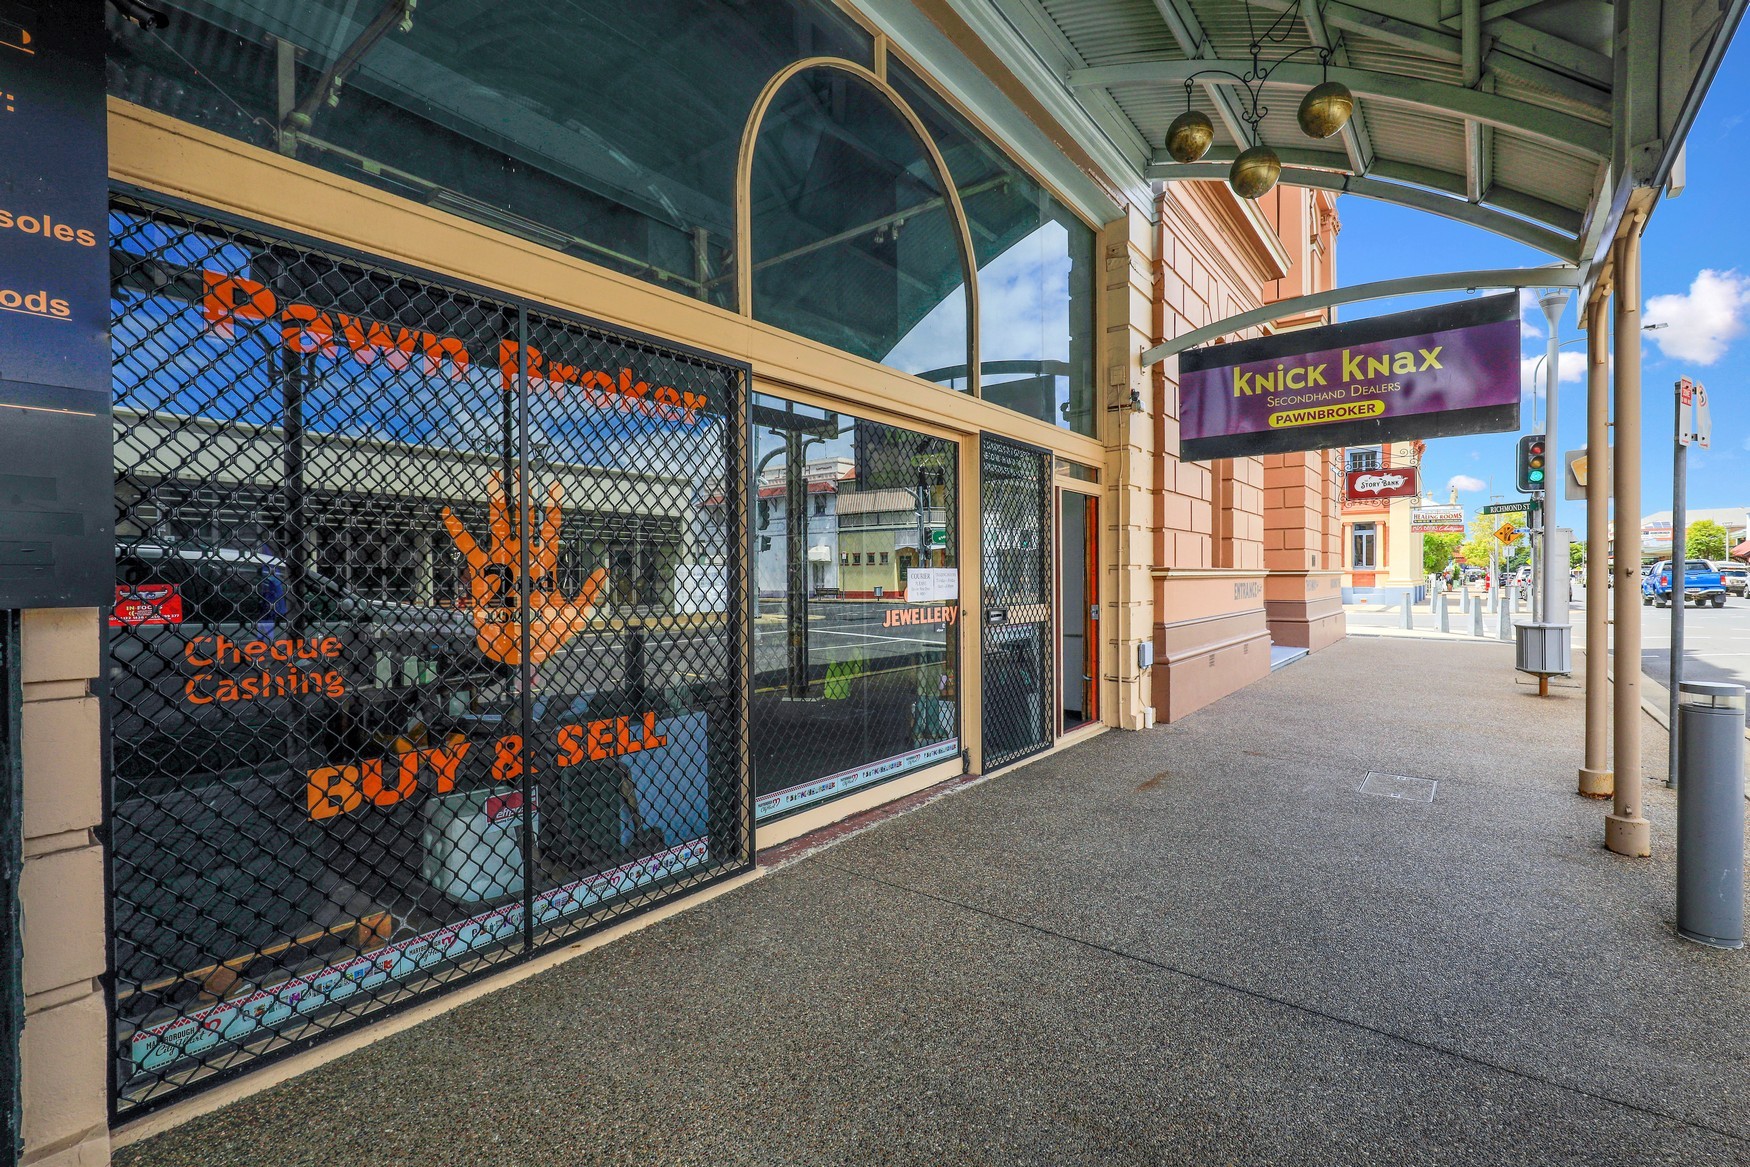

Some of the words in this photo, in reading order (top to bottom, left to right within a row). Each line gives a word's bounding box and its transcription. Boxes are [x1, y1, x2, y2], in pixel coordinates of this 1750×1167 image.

[203, 269, 470, 382] Pawn
[502, 338, 707, 426] Broker
[1275, 403, 1376, 425] PAWNBROKER
[1360, 482, 1381, 490] STORY
[1381, 479, 1400, 488] BANK
[1440, 512, 1462, 520] ROOMS
[1490, 504, 1523, 514] RICHMOND
[1523, 503, 1531, 511] ST
[1234, 581, 1257, 600] ENTRANCE
[883, 605, 959, 628] JEWELLERY
[185, 635, 342, 668] Cheque
[185, 667, 345, 704] Cashing
[306, 740, 472, 822] BUY
[491, 734, 540, 781] &
[557, 711, 668, 767] SELL
